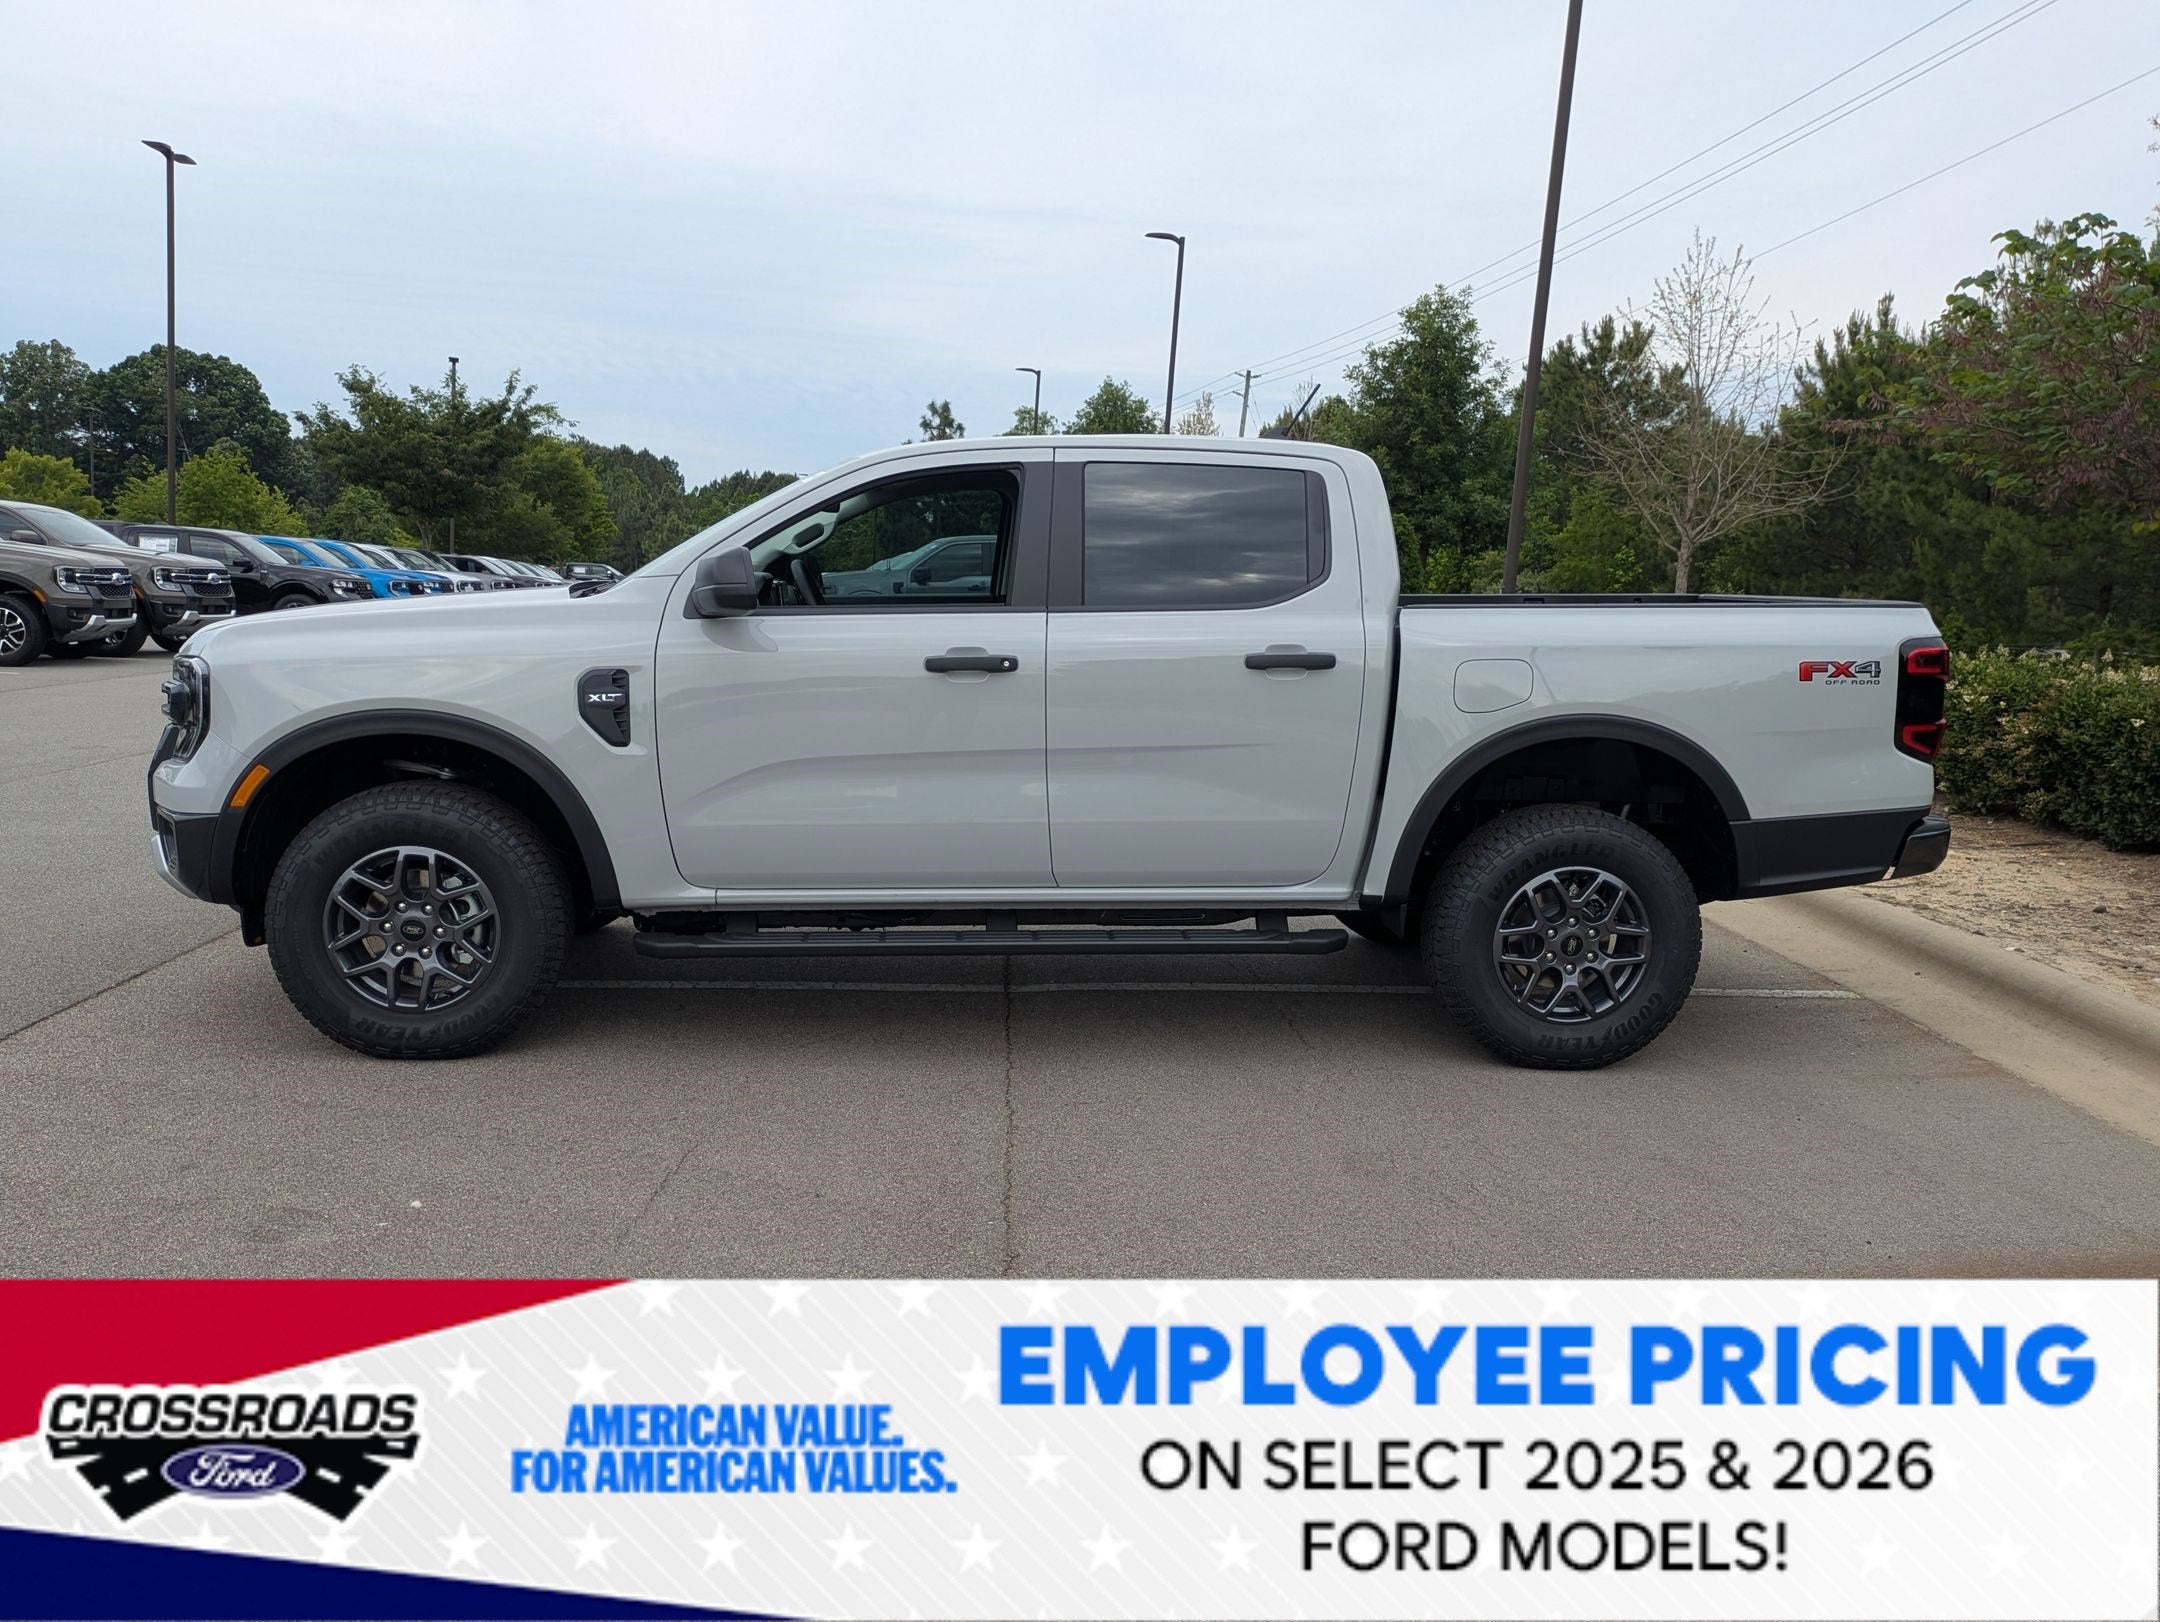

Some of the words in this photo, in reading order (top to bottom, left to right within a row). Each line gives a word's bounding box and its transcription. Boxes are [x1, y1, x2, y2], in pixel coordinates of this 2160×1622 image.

[588, 693, 623, 702] XLT
[1799, 660, 1881, 682] FX4
[1487, 842, 1616, 901] WRANGLER
[355, 986, 503, 1040] GOODYEAR
[1535, 992, 1663, 1051] GOODYEAR
